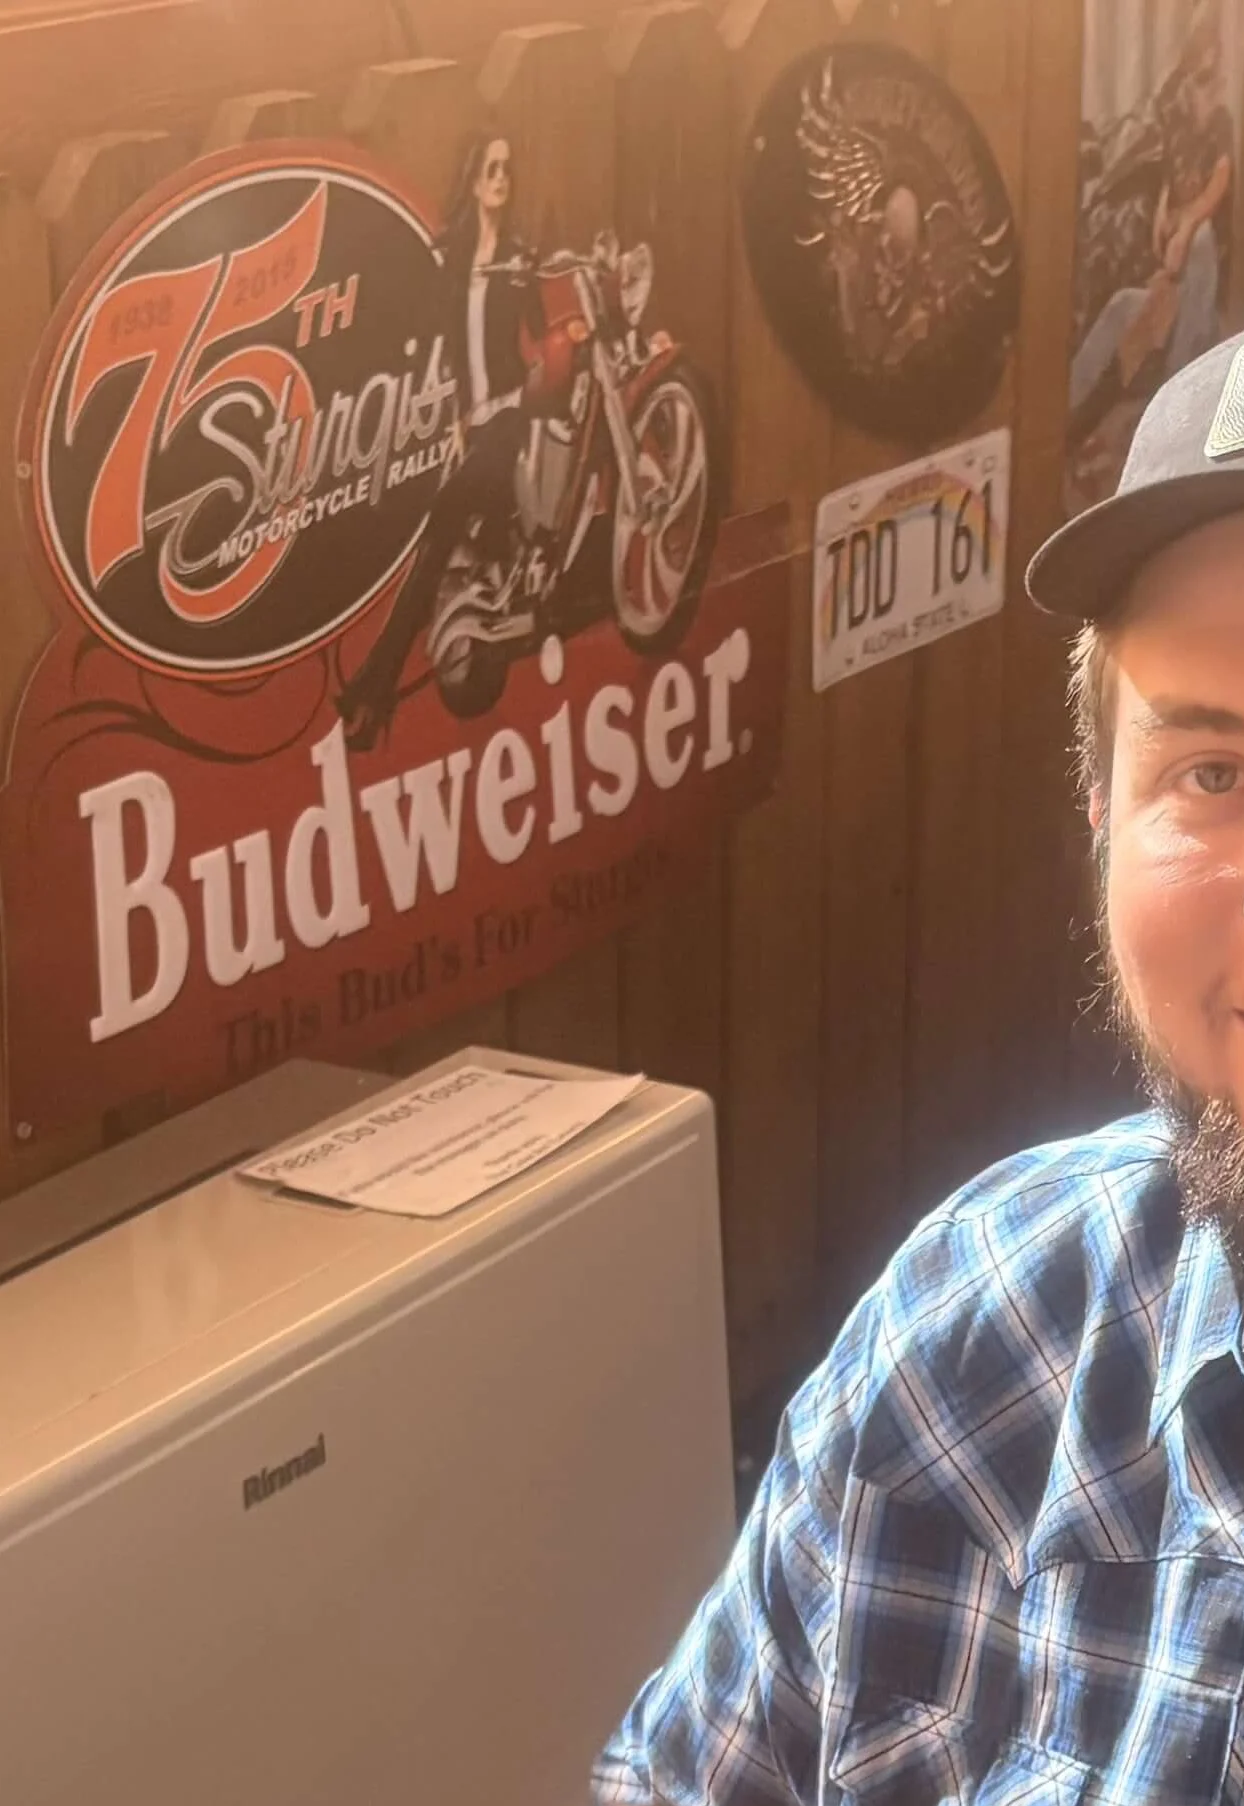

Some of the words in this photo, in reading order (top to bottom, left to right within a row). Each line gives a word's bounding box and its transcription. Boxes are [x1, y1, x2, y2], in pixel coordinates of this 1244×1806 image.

[66, 180, 328, 622] 75
[292, 274, 360, 349] TH
[145, 335, 457, 573] Sturgis
[216, 475, 371, 567] MOTORCYCLE
[386, 430, 458, 489] RALLY
[827, 518, 897, 641] TDD
[931, 478, 993, 597] 161
[79, 628, 750, 1043] Budweiser
[219, 1000, 323, 1078] This
[338, 933, 462, 1027] Bud's
[472, 906, 540, 969] For
[259, 1141, 340, 1177] Please
[333, 1121, 376, 1144] Do
[369, 1101, 423, 1134] Not
[416, 1069, 487, 1105] Touch
[242, 1431, 326, 1511] Rinnai
